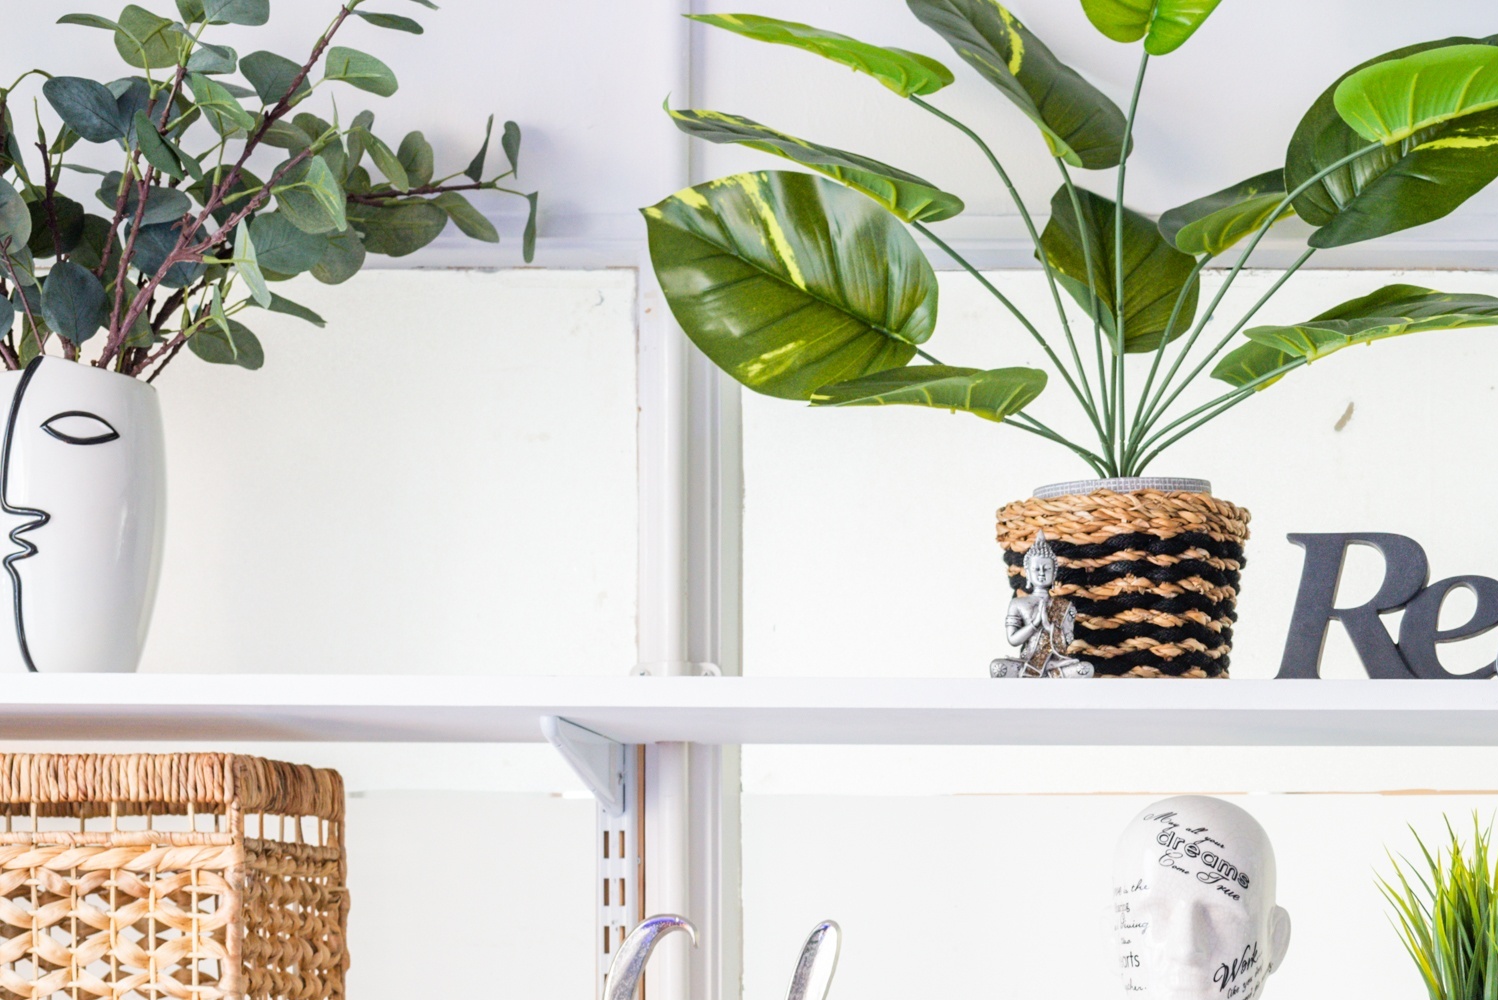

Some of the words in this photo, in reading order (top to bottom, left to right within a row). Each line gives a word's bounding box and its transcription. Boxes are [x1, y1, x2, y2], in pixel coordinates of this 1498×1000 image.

[1156, 831, 1250, 890] dreams
[1158, 849, 1190, 875] Come
[1196, 871, 1240, 901] True
